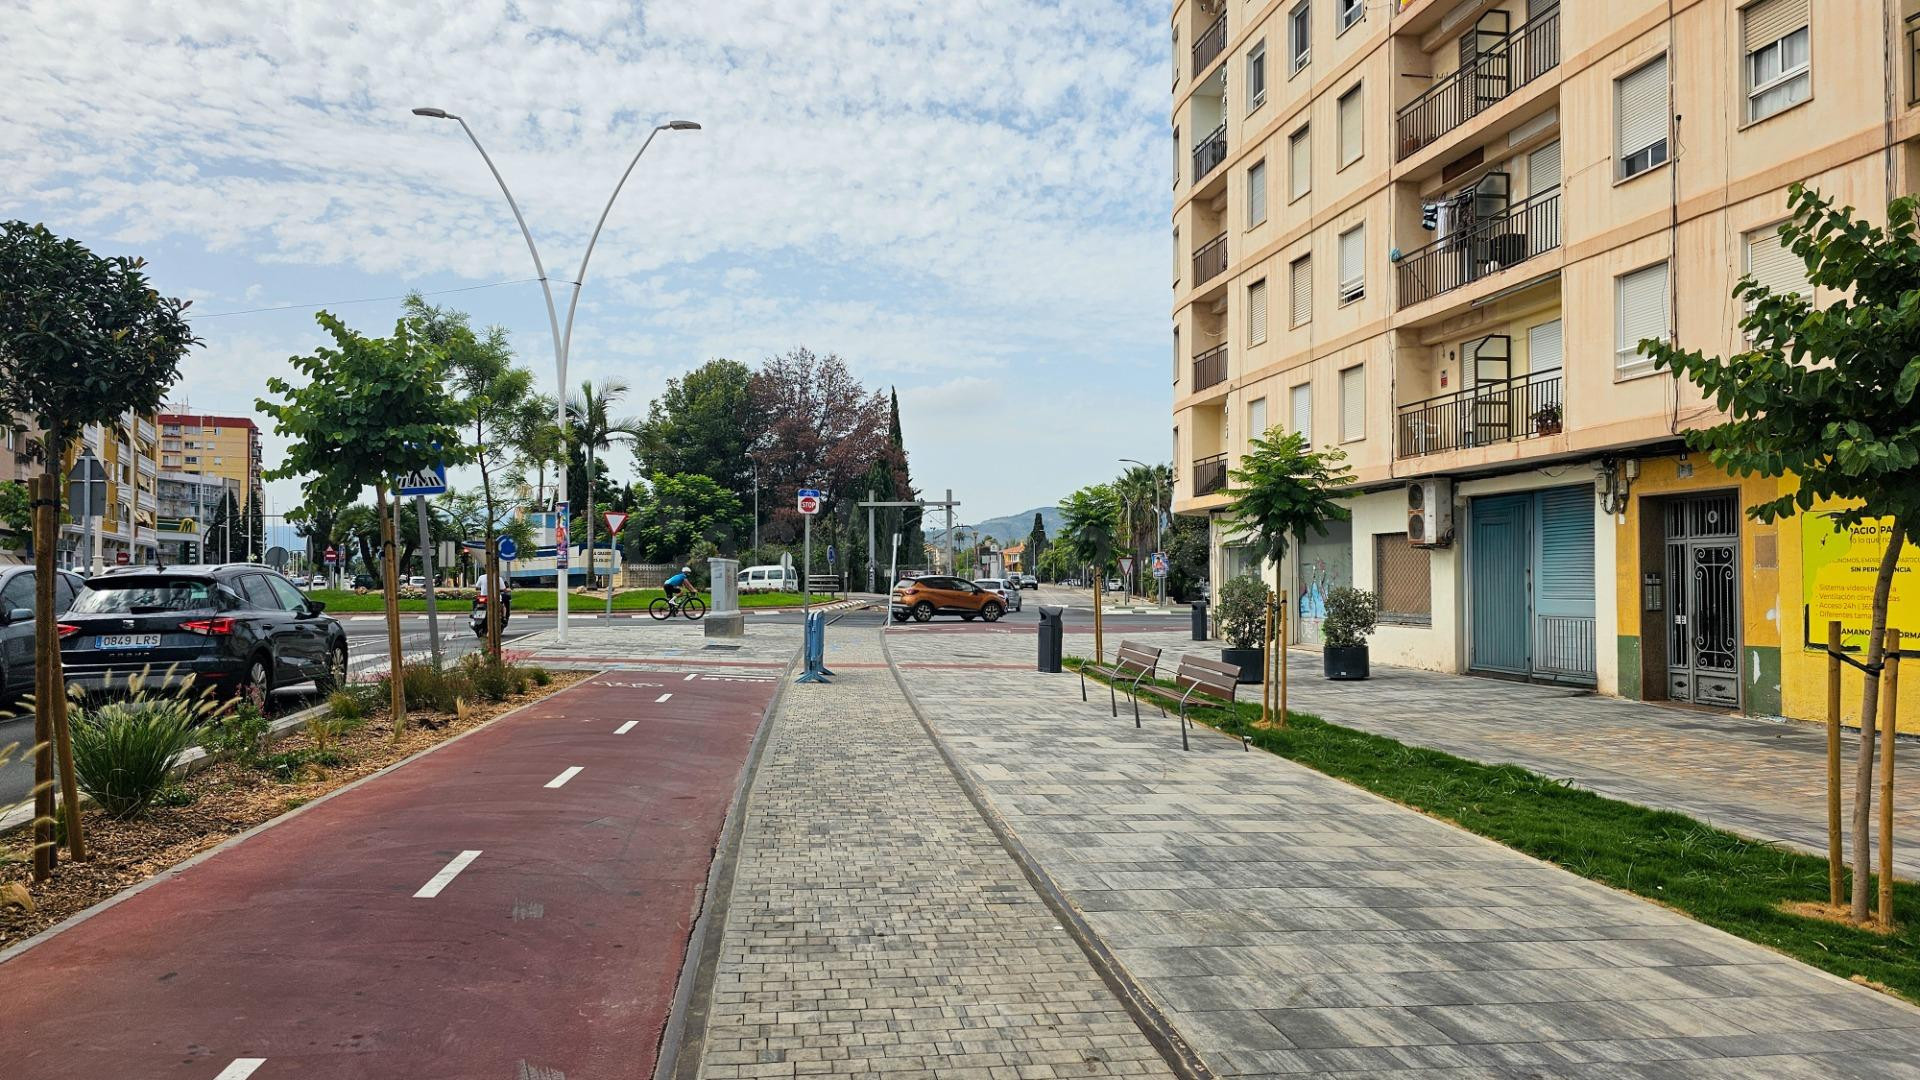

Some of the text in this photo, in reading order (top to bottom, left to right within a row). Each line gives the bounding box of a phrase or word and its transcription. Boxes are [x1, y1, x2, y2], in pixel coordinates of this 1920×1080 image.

[1843, 602, 1856, 610] 24h
[1819, 611, 1853, 619] Diferentes
[104, 635, 158, 646] 0849 LRS
